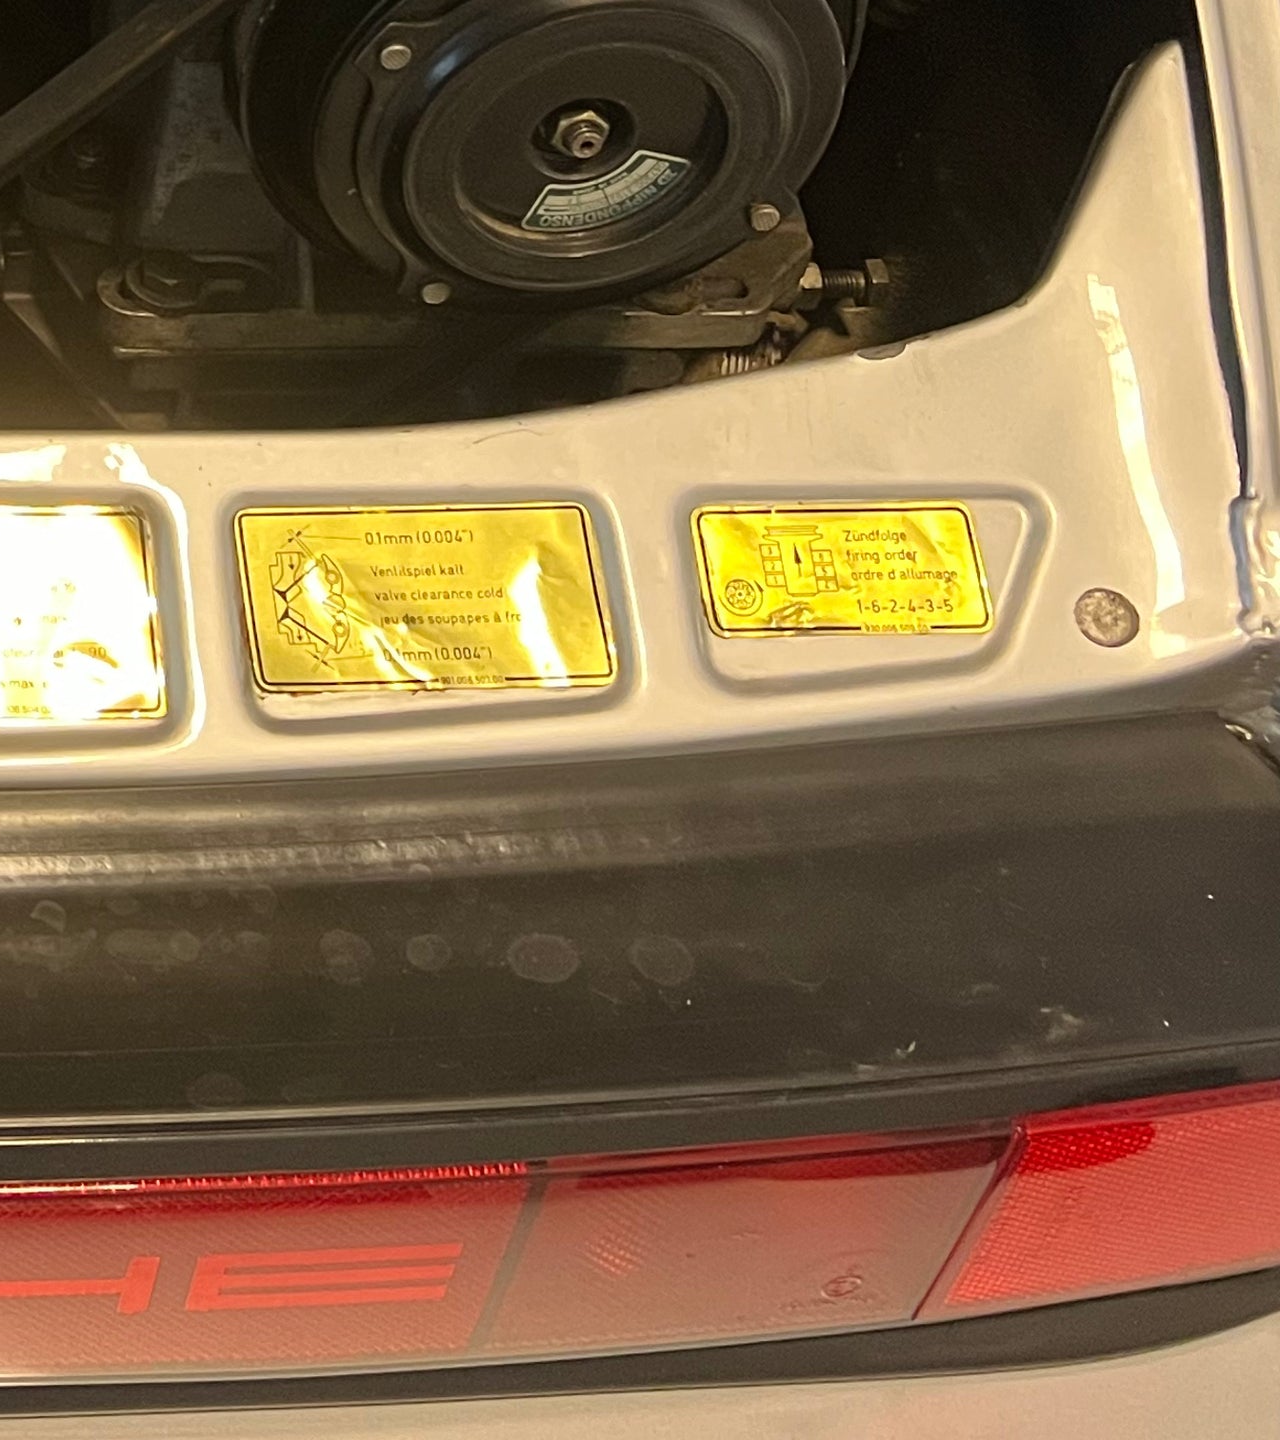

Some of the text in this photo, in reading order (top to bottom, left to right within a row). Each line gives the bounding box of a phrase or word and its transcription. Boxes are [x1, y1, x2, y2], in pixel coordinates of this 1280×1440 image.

[539, 183, 657, 228] NIPPONDENSO
[846, 549, 917, 564] firing order
[440, 564, 464, 575] kalt
[851, 569, 884, 581] ordre
[375, 587, 504, 600] valve clearance cold
[380, 614, 399, 627] jeu
[402, 613, 424, 624] des
[428, 613, 490, 626] soupapes
